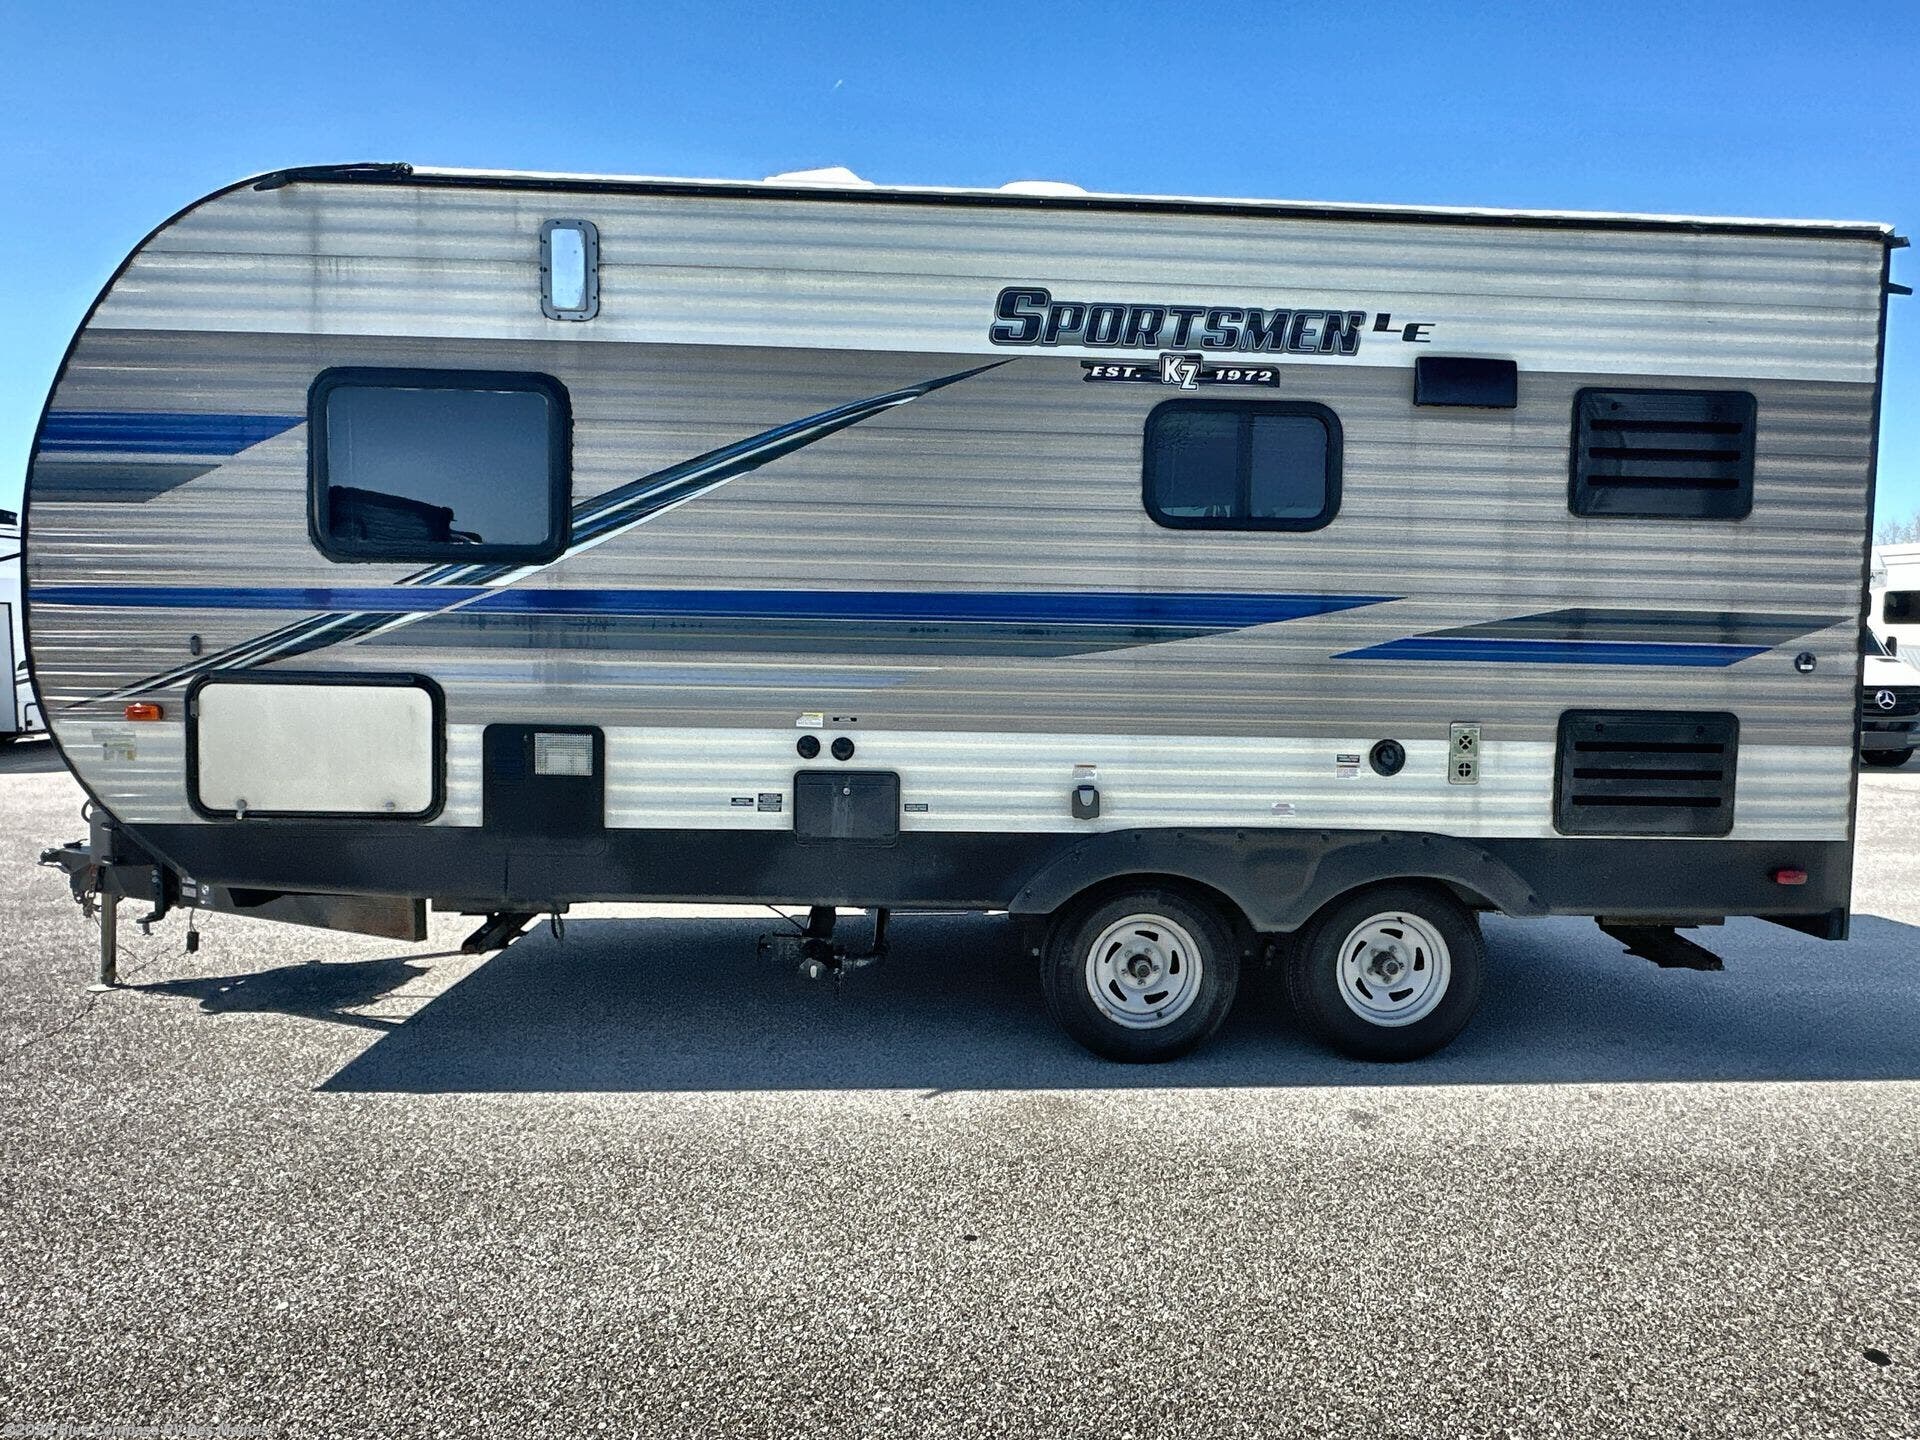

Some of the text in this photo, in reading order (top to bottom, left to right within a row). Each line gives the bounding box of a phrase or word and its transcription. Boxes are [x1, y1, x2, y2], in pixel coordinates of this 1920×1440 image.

[988, 286, 1437, 356] SPORTSMEN LE
[1091, 354, 1273, 392] EST. KZ 1972
